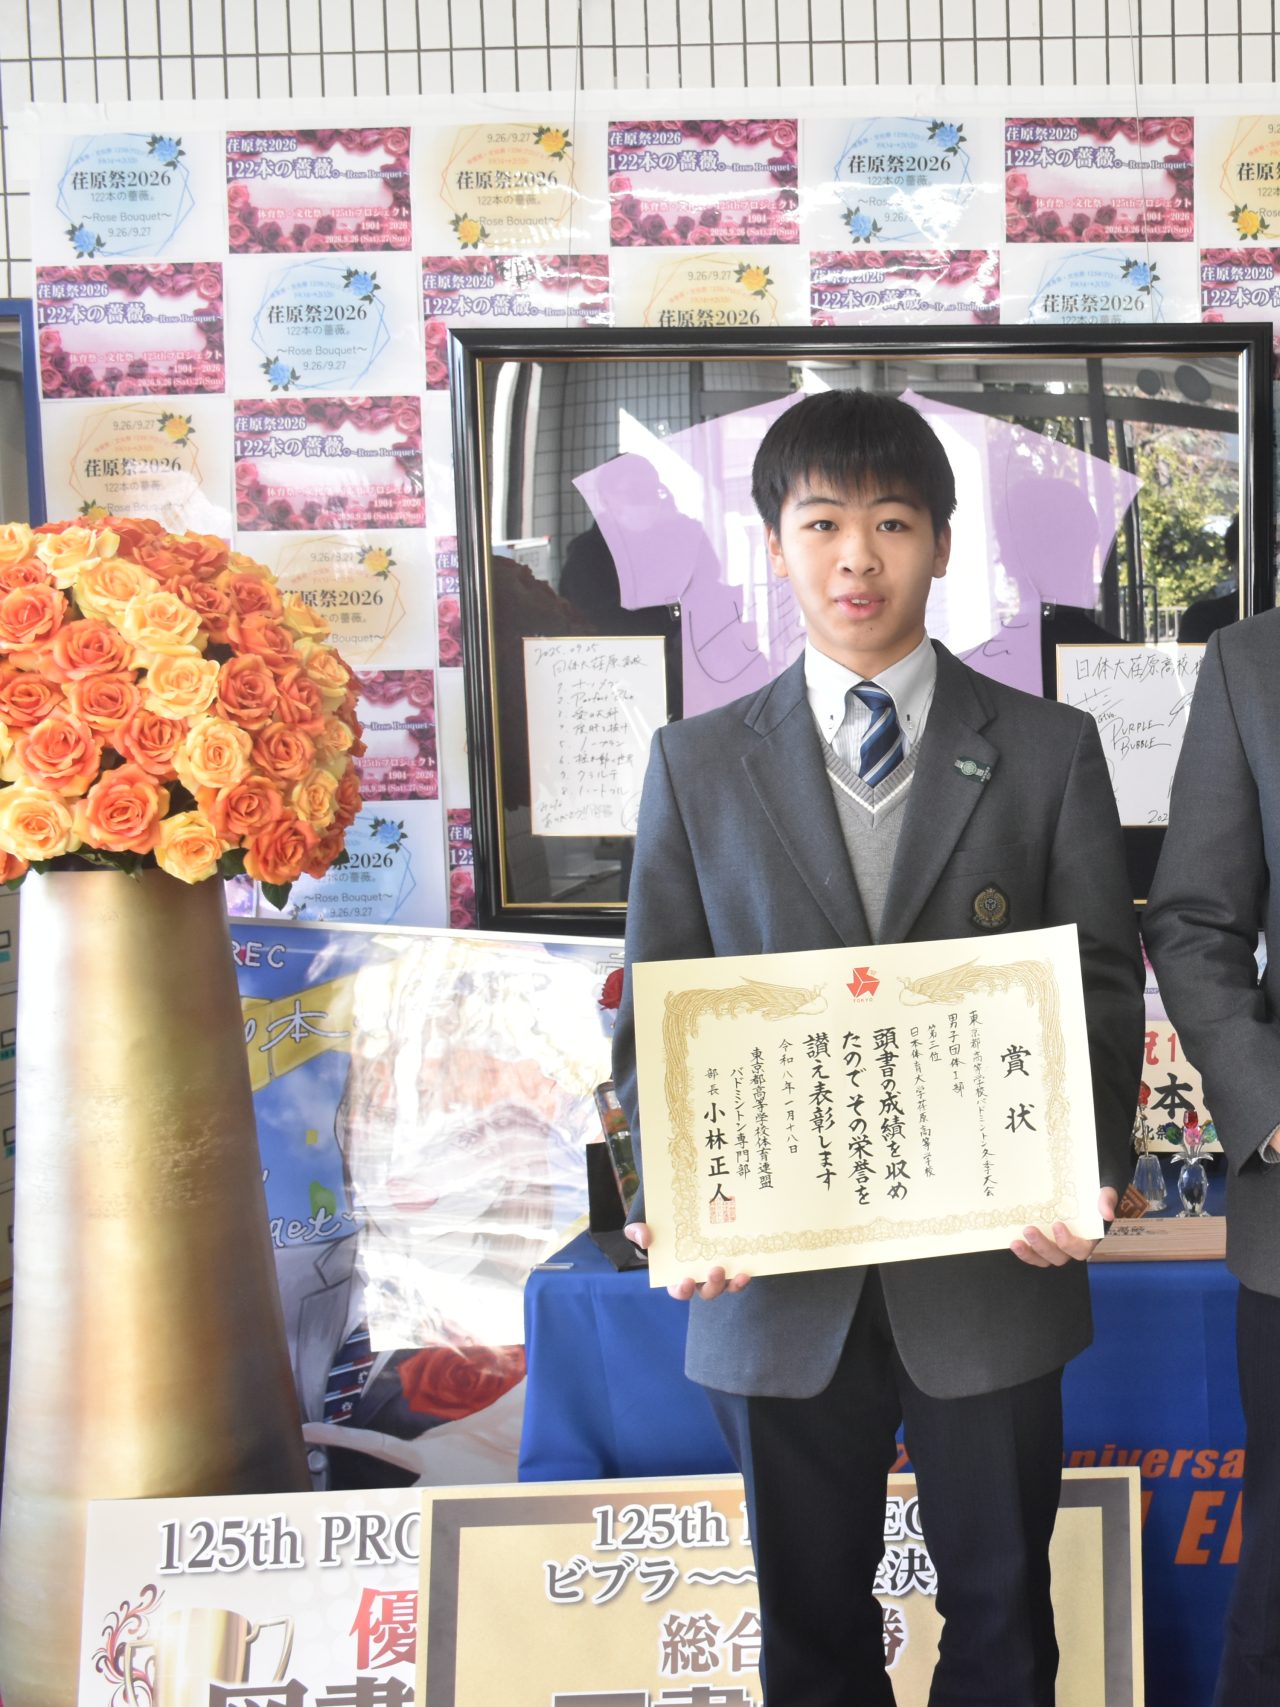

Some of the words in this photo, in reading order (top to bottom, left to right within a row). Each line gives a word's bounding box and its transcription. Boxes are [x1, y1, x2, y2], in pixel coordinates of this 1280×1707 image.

[487, 134, 531, 146] 9.26/9.27
[611, 132, 682, 147] 荏原祭2026
[1007, 129, 1078, 144] 荏原祭2026
[228, 140, 297, 156] 荏原祭2026
[610, 152, 728, 173] 122本の薔薇。
[849, 155, 951, 174] 荏原祭2026
[1006, 148, 1123, 170] 122本の薔薇。
[72, 171, 171, 190] 荏原祭2026
[227, 160, 342, 181] 122本の薔薇。
[456, 170, 558, 192] 荏原祭2026
[91, 191, 153, 201] 122本の薔薇。
[477, 194, 541, 207] 122本の薔薇。
[109, 227, 151, 237] 9.26/9.27
[424, 274, 495, 291] 荏原祭2026
[689, 271, 733, 283] 9.26/9.27
[1202, 265, 1273, 282] 荏原祭2026
[38, 284, 110, 301] 荏原祭2026
[268, 305, 367, 323] 荏原祭2026
[424, 296, 540, 318] 122本の薔薇。
[1043, 294, 1144, 314] 荏原祭2026
[38, 304, 155, 328] 122本の薔薇。
[658, 308, 760, 329] 荏原祭2026
[287, 325, 349, 335] 122本の薔薇。
[304, 361, 346, 370] 9.26/9.27
[113, 422, 155, 434] 9.26/9.27
[236, 417, 307, 434] 荏原祭2026
[236, 438, 352, 460] 122本の薔薇。
[85, 456, 181, 478] 荏原祭2026
[330, 908, 372, 918] 9.26/9.27
[927, 1023, 942, 1062] 第三位
[705, 1067, 720, 1096] 部長
[1000, 1044, 1037, 1133] 賞状
[778, 1038, 799, 1154] 令和八年一月十八日
[910, 1026, 936, 1178] 日本体育大学荏原高等学校
[1150, 1072, 1196, 1119] 本
[749, 1046, 774, 1190] 東京都高等学校体育連盟
[802, 1032, 837, 1191] 讃え表彰します
[842, 1030, 877, 1205] たのでその栄誉を
[872, 1026, 912, 1201] 頭書の成績を収め
[730, 1066, 751, 1180] バドミントン専門部
[703, 1102, 732, 1203] 小林正人
[595, 1505, 727, 1550] 125th
[159, 1515, 302, 1571] 125th
